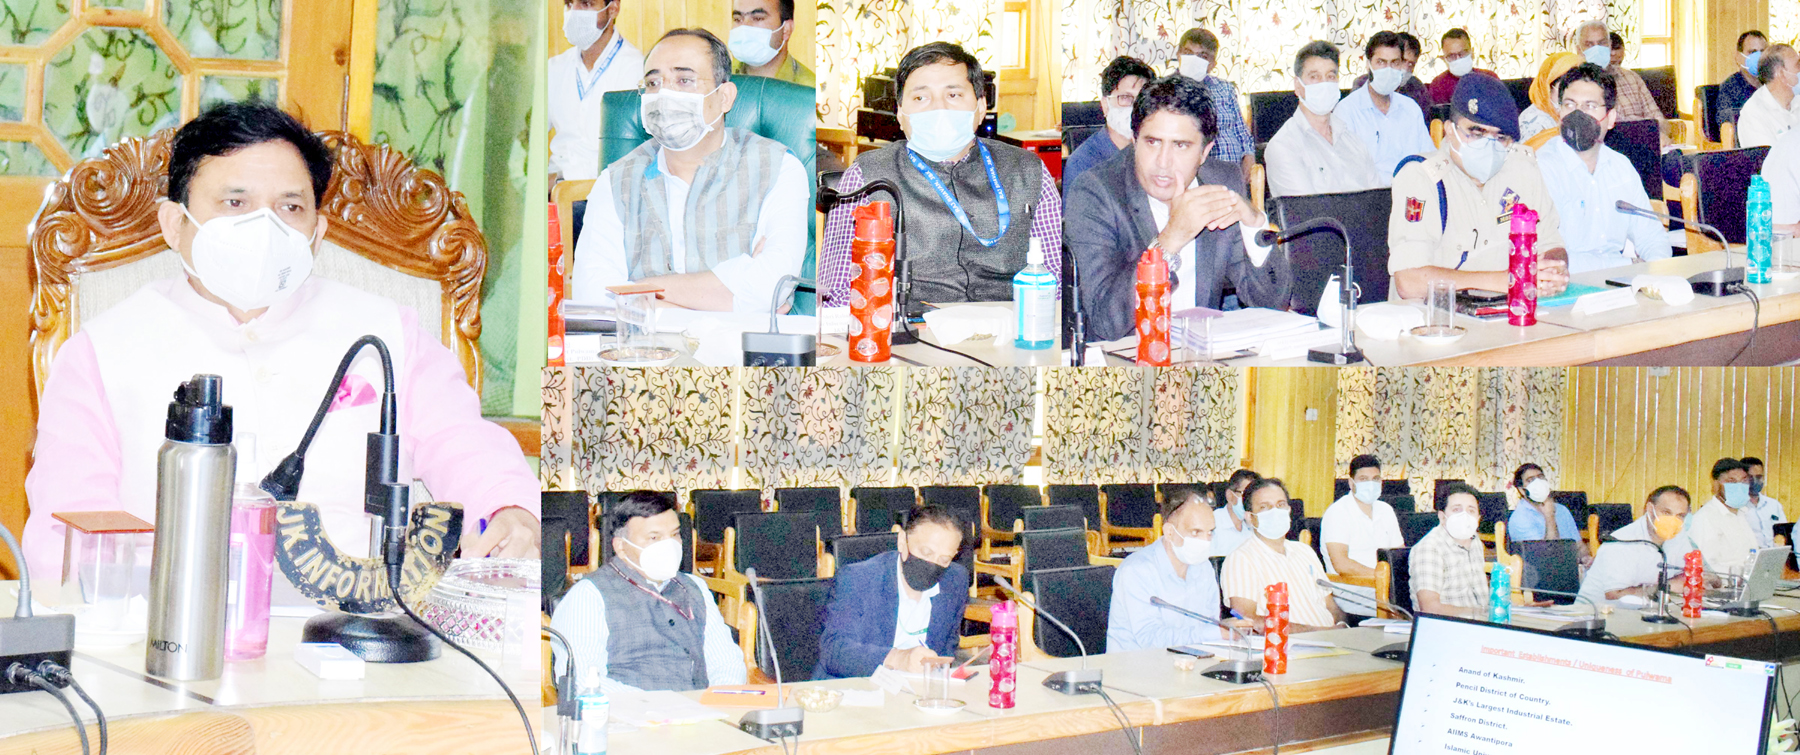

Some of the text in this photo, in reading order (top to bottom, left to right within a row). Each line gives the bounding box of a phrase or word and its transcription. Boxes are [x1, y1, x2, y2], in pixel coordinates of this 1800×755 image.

[276, 508, 309, 551] JK
[150, 638, 188, 653] MILTON
[1481, 645, 1515, 658] Important
[1579, 660, 1622, 676] Uniqueness
[1626, 668, 1635, 678] of
[1636, 670, 1672, 684] Pulwama
[1458, 666, 1481, 676] Anand
[1493, 672, 1525, 684] Kashmir.
[1456, 681, 1478, 691] Pencil
[1480, 686, 1507, 697] District
[1519, 693, 1551, 706] Country.
[1450, 712, 1508, 730] Saffron District.
[1453, 697, 1573, 726] J&K's Largest Industrial Estate.
[1447, 728, 1513, 747] AIIMS Awantipora
[1444, 743, 1470, 755] Islamic
